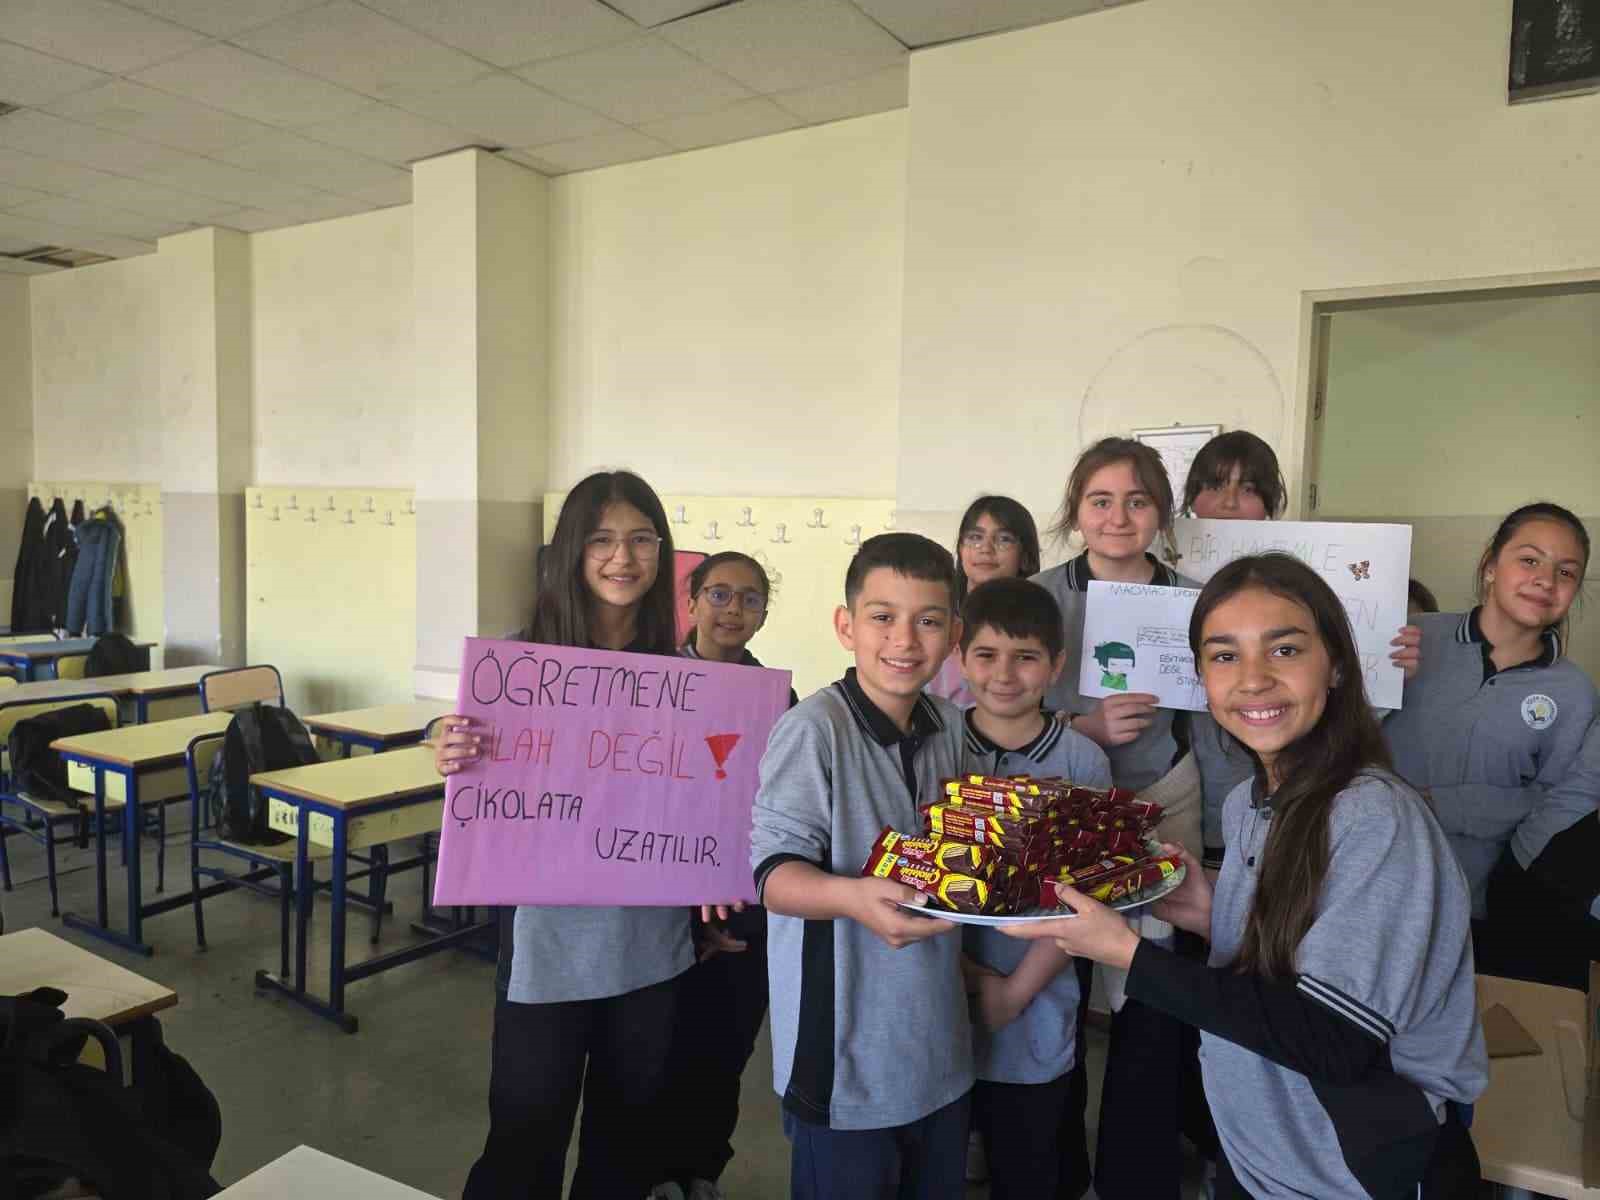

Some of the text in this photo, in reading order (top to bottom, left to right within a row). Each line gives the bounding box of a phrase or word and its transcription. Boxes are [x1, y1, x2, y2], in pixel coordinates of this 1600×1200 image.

[471, 647, 706, 712] ÖĞRETMENE
[451, 781, 583, 828] ÇİKOLATA
[595, 826, 721, 868] UZATILIR.
